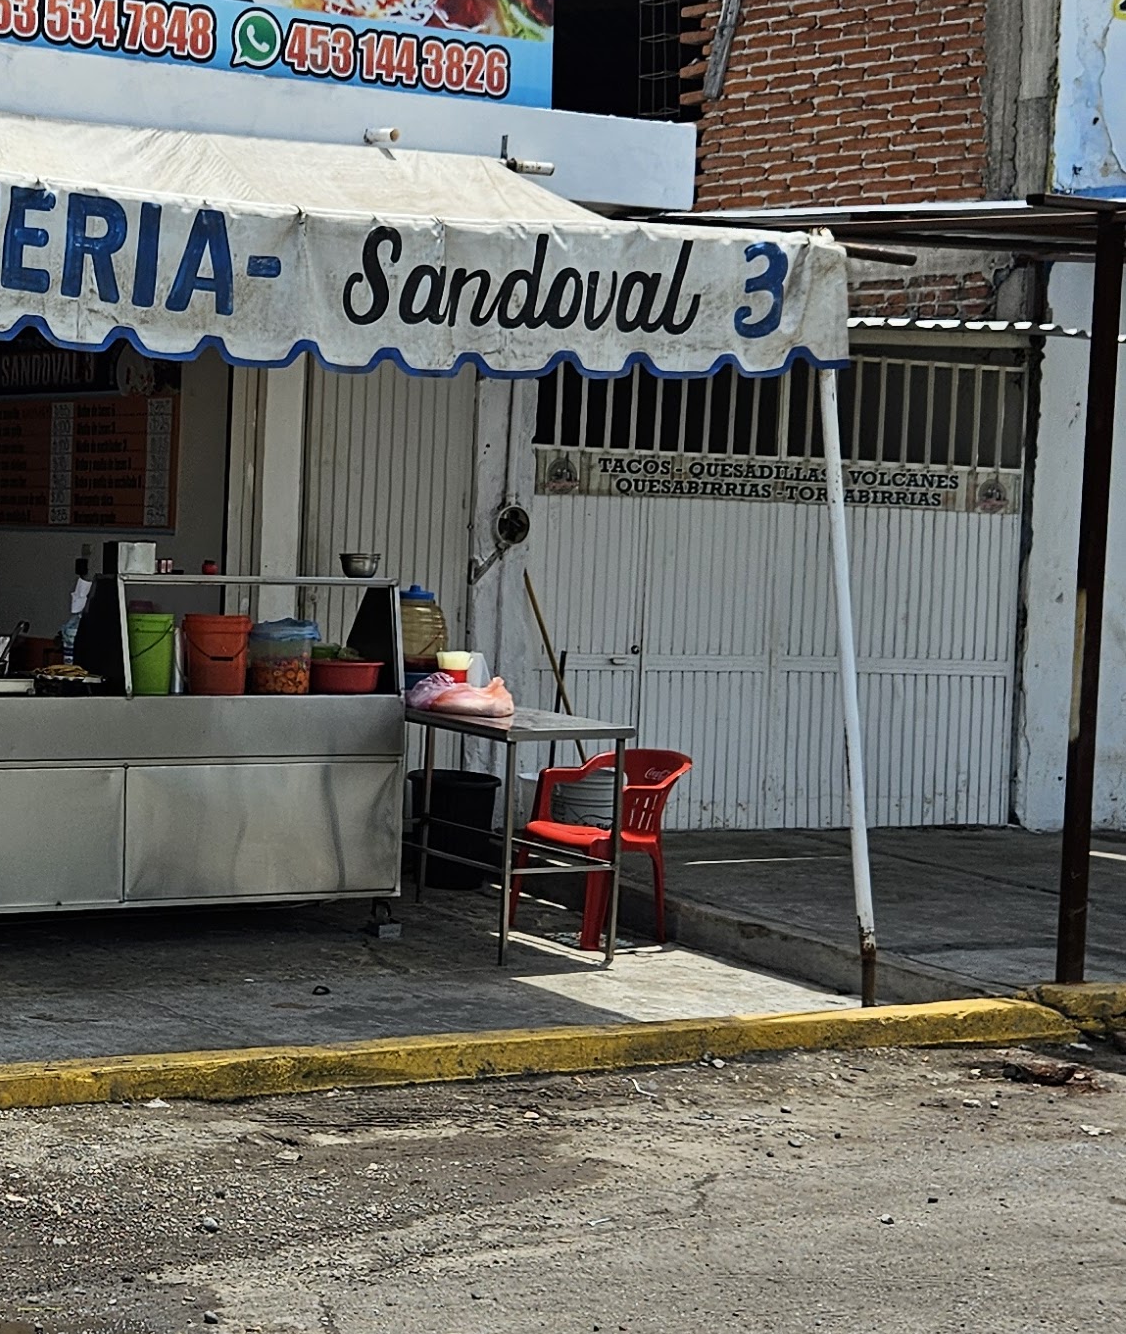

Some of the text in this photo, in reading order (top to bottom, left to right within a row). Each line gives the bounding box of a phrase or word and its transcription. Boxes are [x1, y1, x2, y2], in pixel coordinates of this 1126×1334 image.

[285, 23, 509, 97] 453 144 3826
[342, 224, 701, 335] Sandoval
[733, 240, 790, 338] 3
[598, 456, 672, 475] TACOS
[848, 470, 960, 490] VOLCANES
[615, 477, 942, 507] QUESABIRRIAS -TORABIRRIAS
